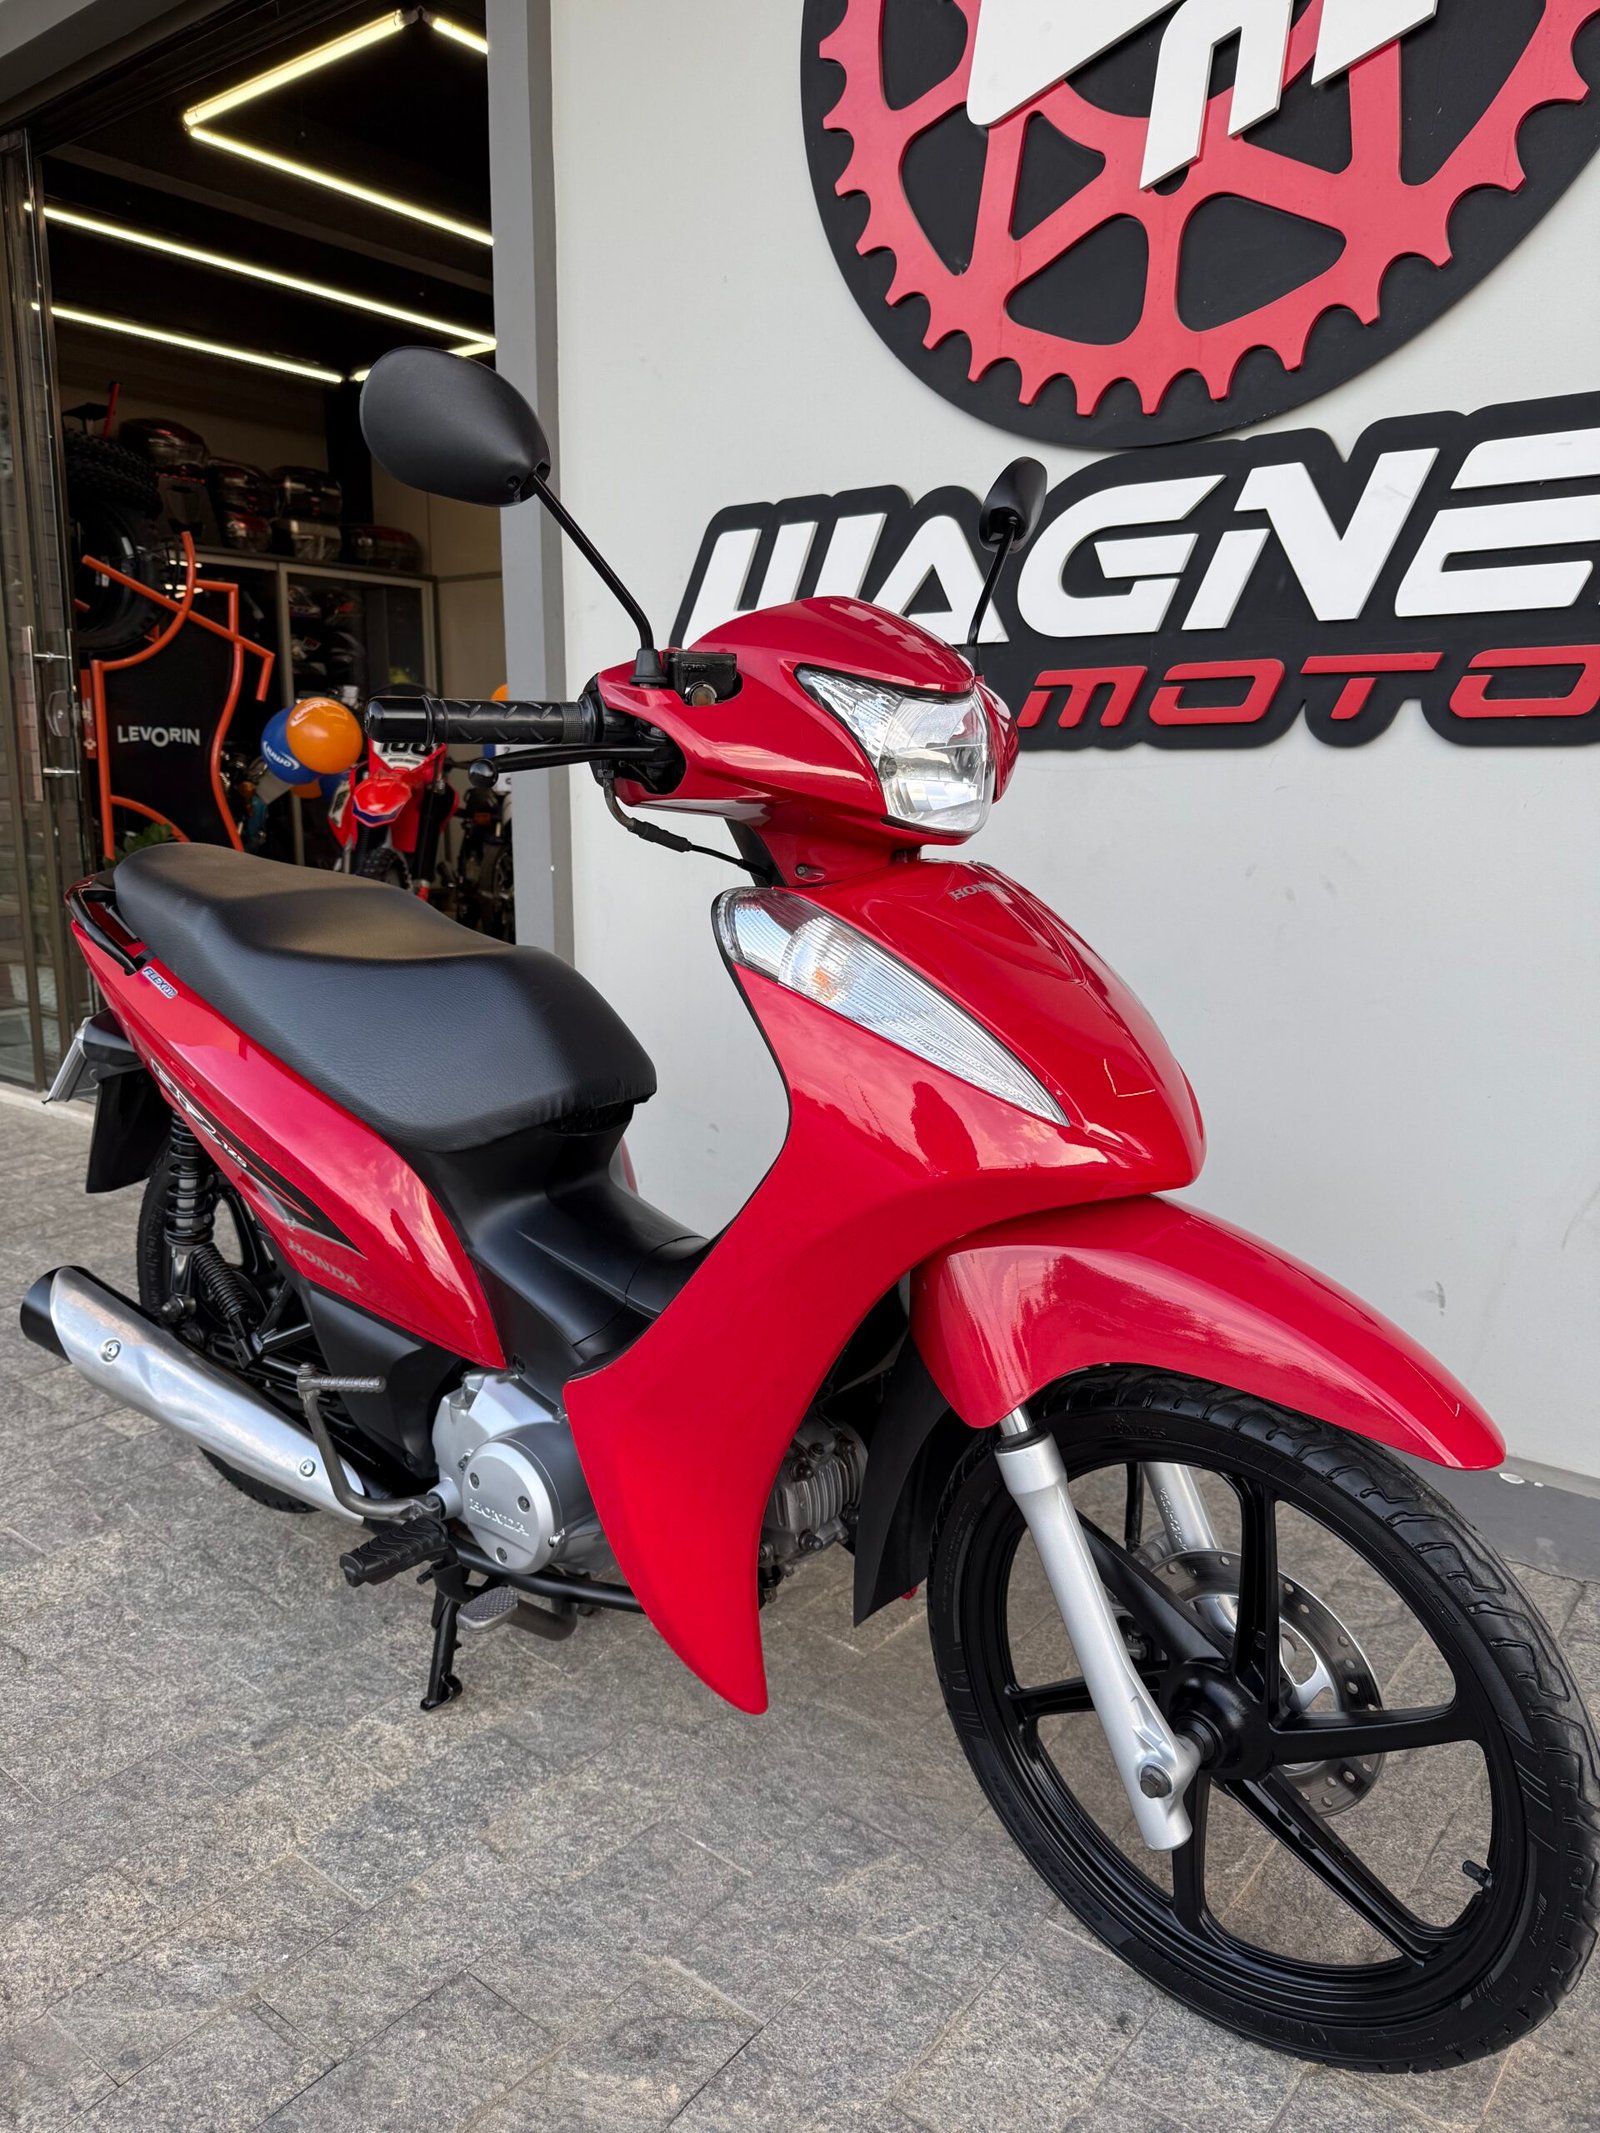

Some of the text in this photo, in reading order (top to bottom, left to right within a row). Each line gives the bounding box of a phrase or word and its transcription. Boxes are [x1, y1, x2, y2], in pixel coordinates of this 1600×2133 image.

[1019, 645, 1600, 728] MOTO
[117, 726, 200, 748] LEVORIN
[287, 1237, 363, 1291] HONDA
